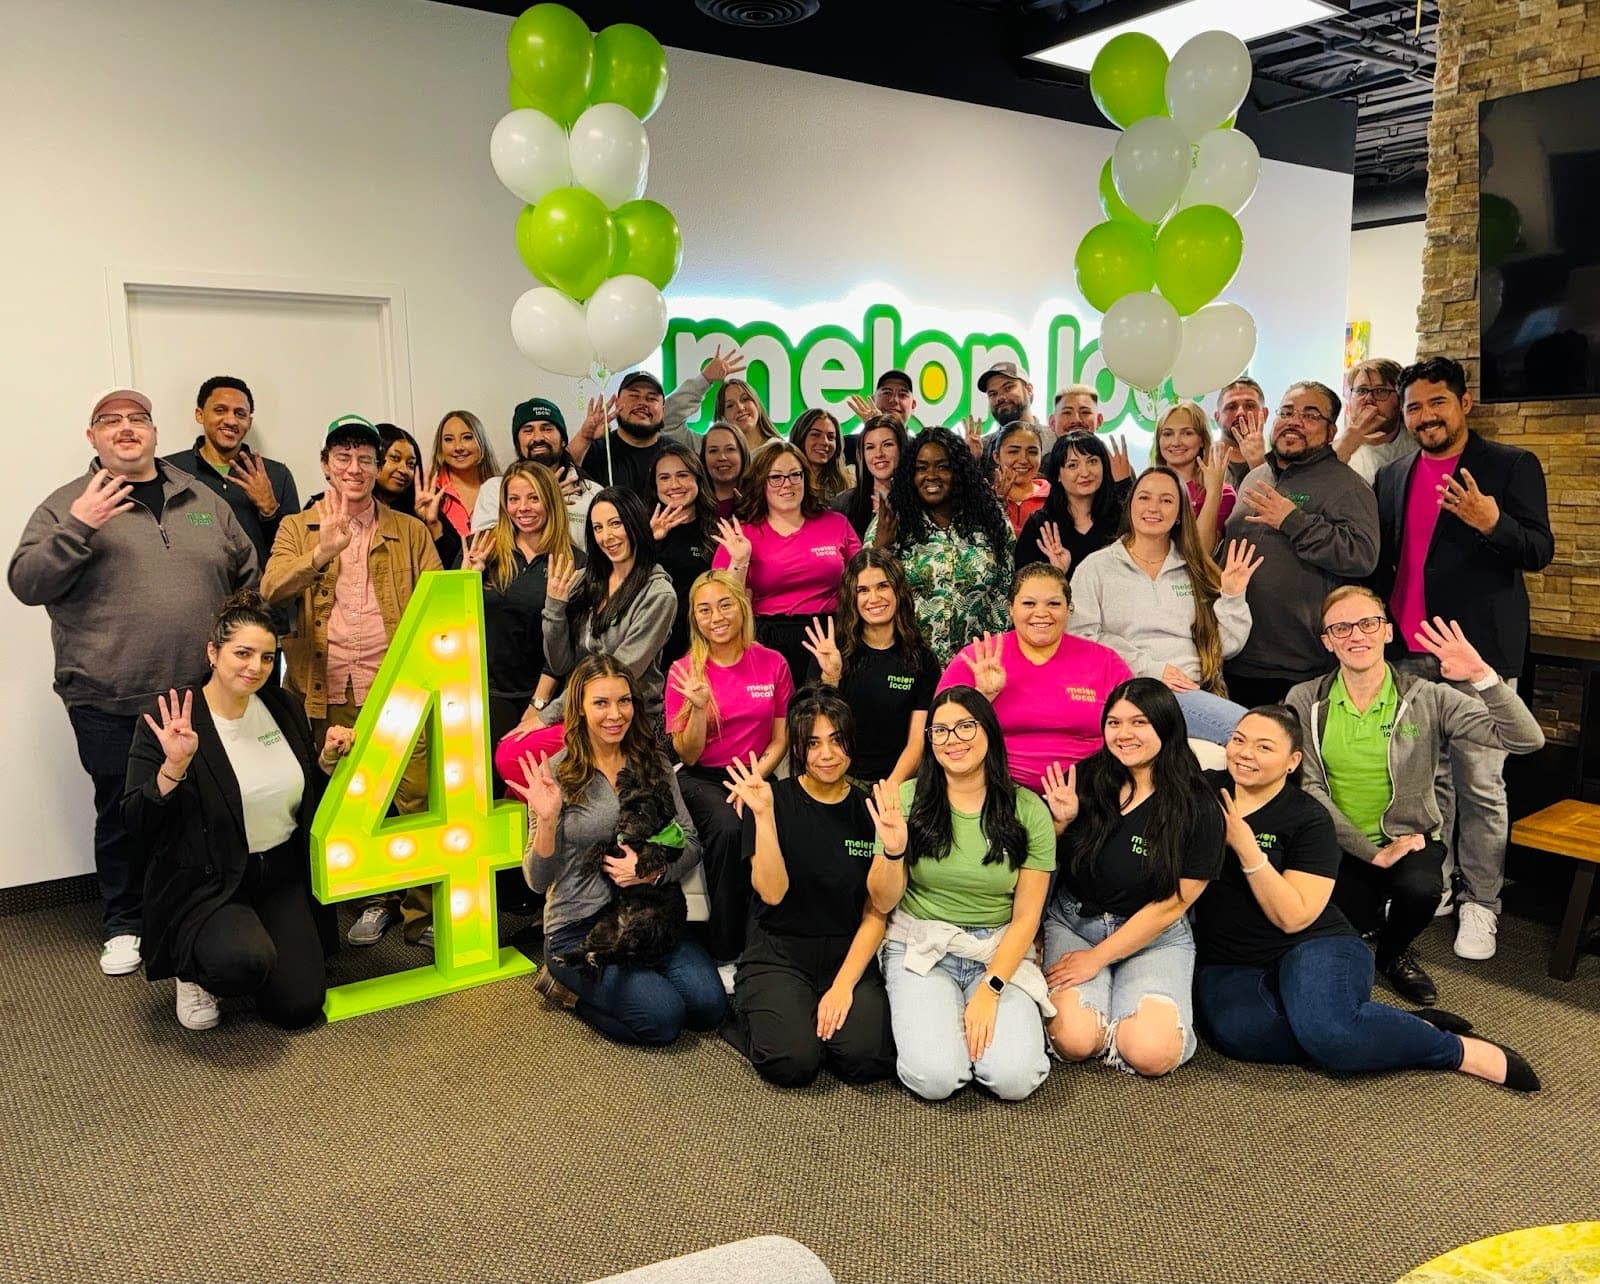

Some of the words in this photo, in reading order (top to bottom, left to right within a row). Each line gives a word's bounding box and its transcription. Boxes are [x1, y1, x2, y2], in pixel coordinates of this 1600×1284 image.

[674, 316, 1021, 427] melon
[887, 675, 915, 684] melon
[747, 683, 775, 692] melon
[889, 681, 912, 690] local
[751, 690, 774, 698] local
[1066, 687, 1096, 696] melon
[1071, 693, 1096, 702] local
[257, 730, 281, 742] melon
[263, 736, 281, 746] local
[310, 570, 527, 978] 4
[844, 839, 875, 849] melon
[848, 847, 872, 858] local
[1132, 844, 1148, 856] loc
